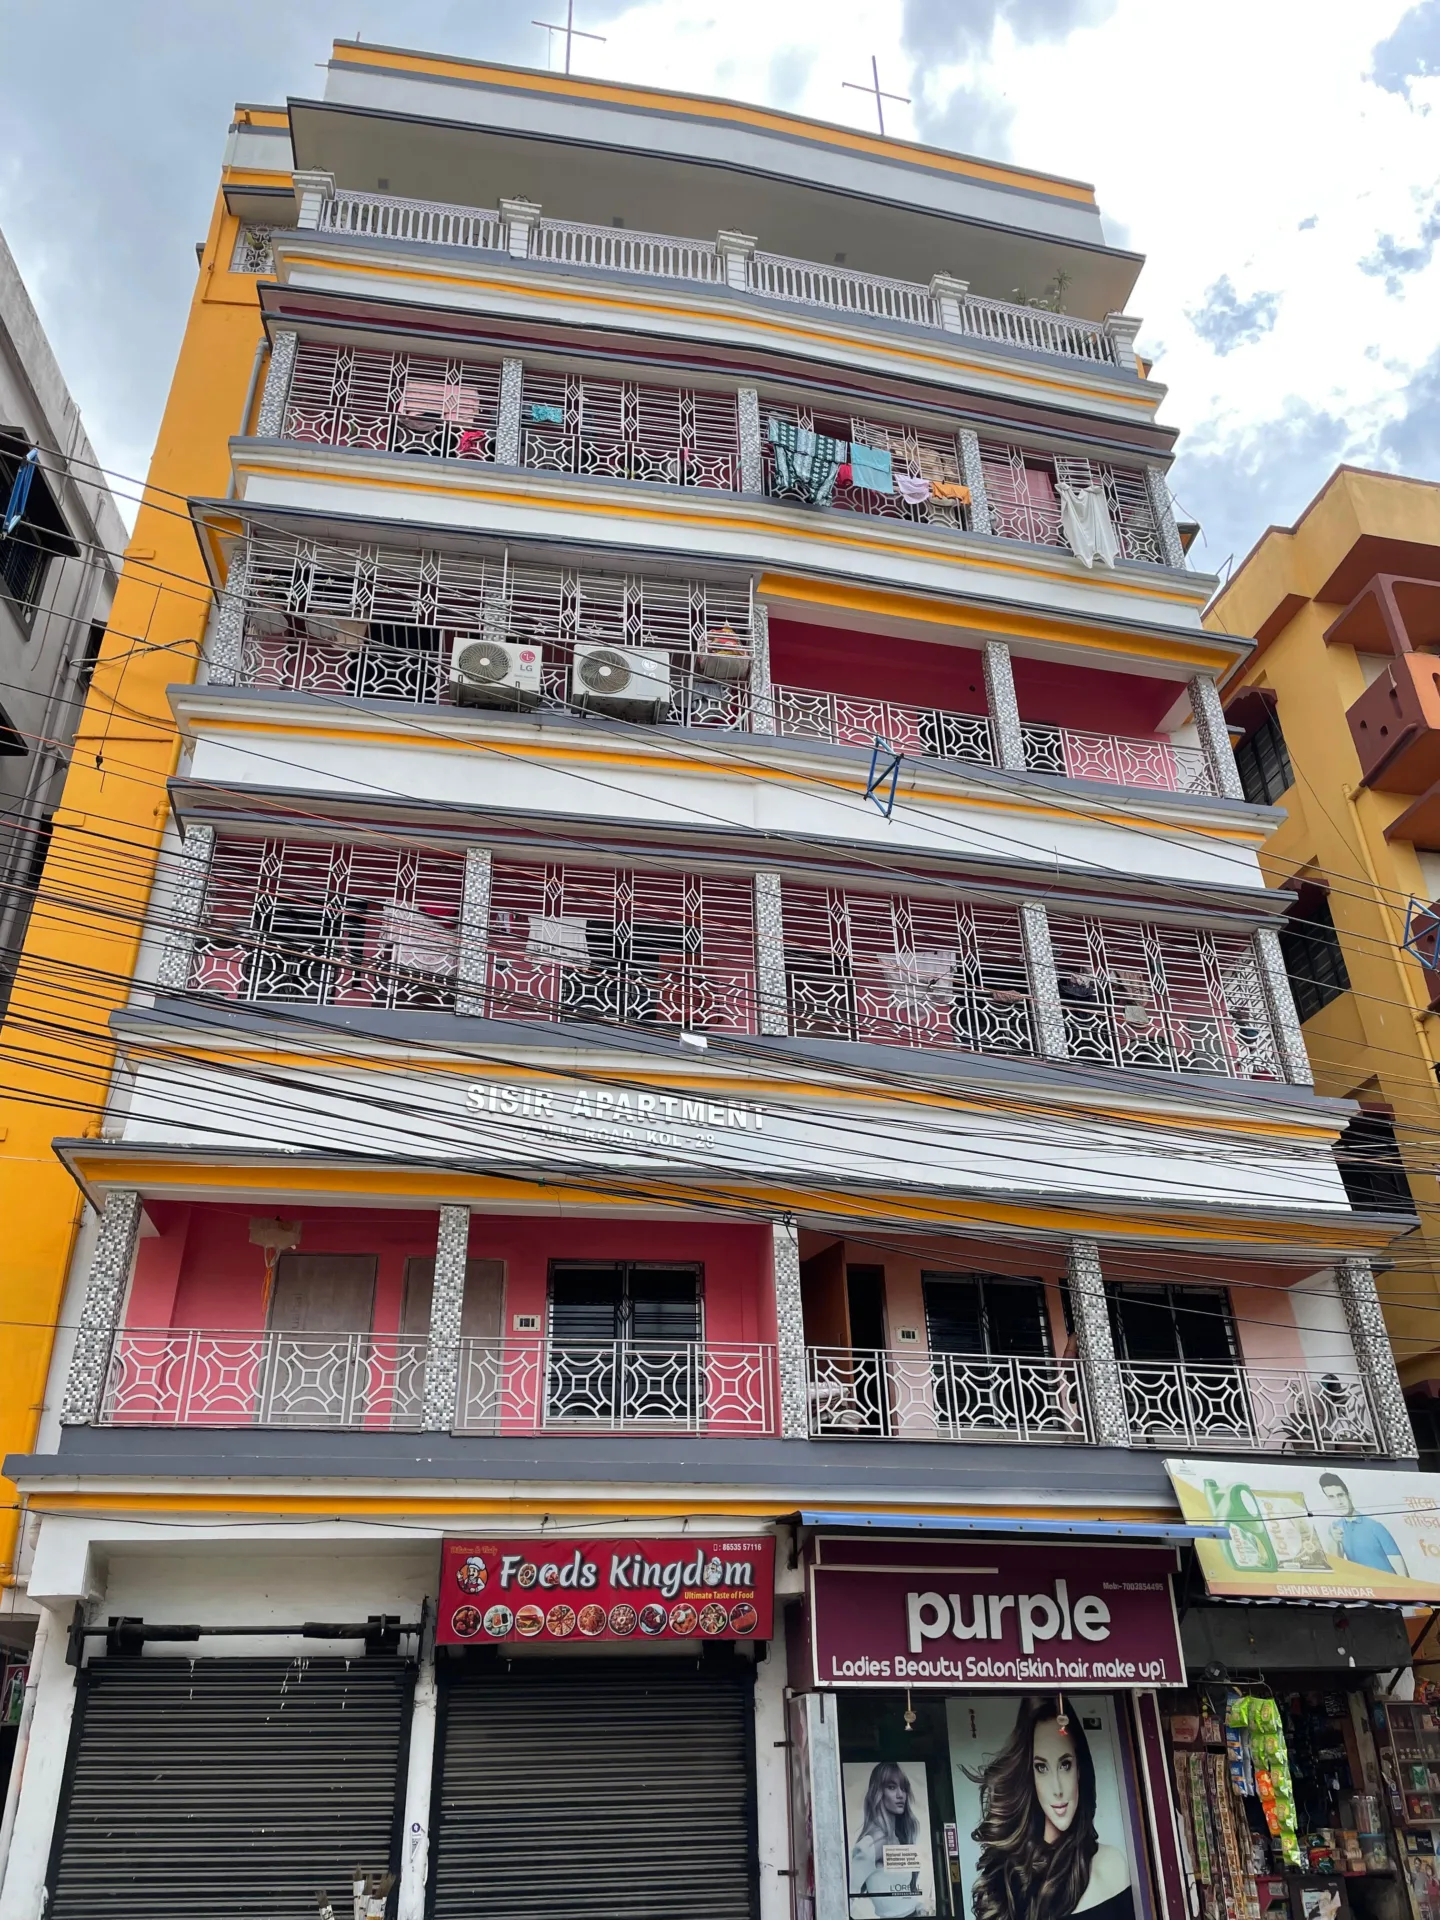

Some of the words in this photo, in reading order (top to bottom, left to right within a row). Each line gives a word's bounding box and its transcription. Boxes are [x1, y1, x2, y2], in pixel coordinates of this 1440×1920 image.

[519, 664, 533, 672] LG
[465, 1084, 554, 1117] SISIR
[570, 1090, 767, 1129] APARTMENT
[1231, 1527, 1249, 1565] fortune
[1264, 1502, 1290, 1556] fortune
[499, 1548, 597, 1588] Foods
[609, 1548, 754, 1597] Kingdom
[1276, 1584, 1319, 1595] SHIVANI
[1320, 1585, 1375, 1597] BHANDAR
[684, 1591, 712, 1600] Ultimate
[713, 1591, 730, 1599] Taste
[731, 1591, 738, 1599] of
[738, 1591, 754, 1599] Food
[905, 1578, 1111, 1654] purple
[832, 1655, 891, 1676] Ladies
[894, 1655, 963, 1681] Beauty
